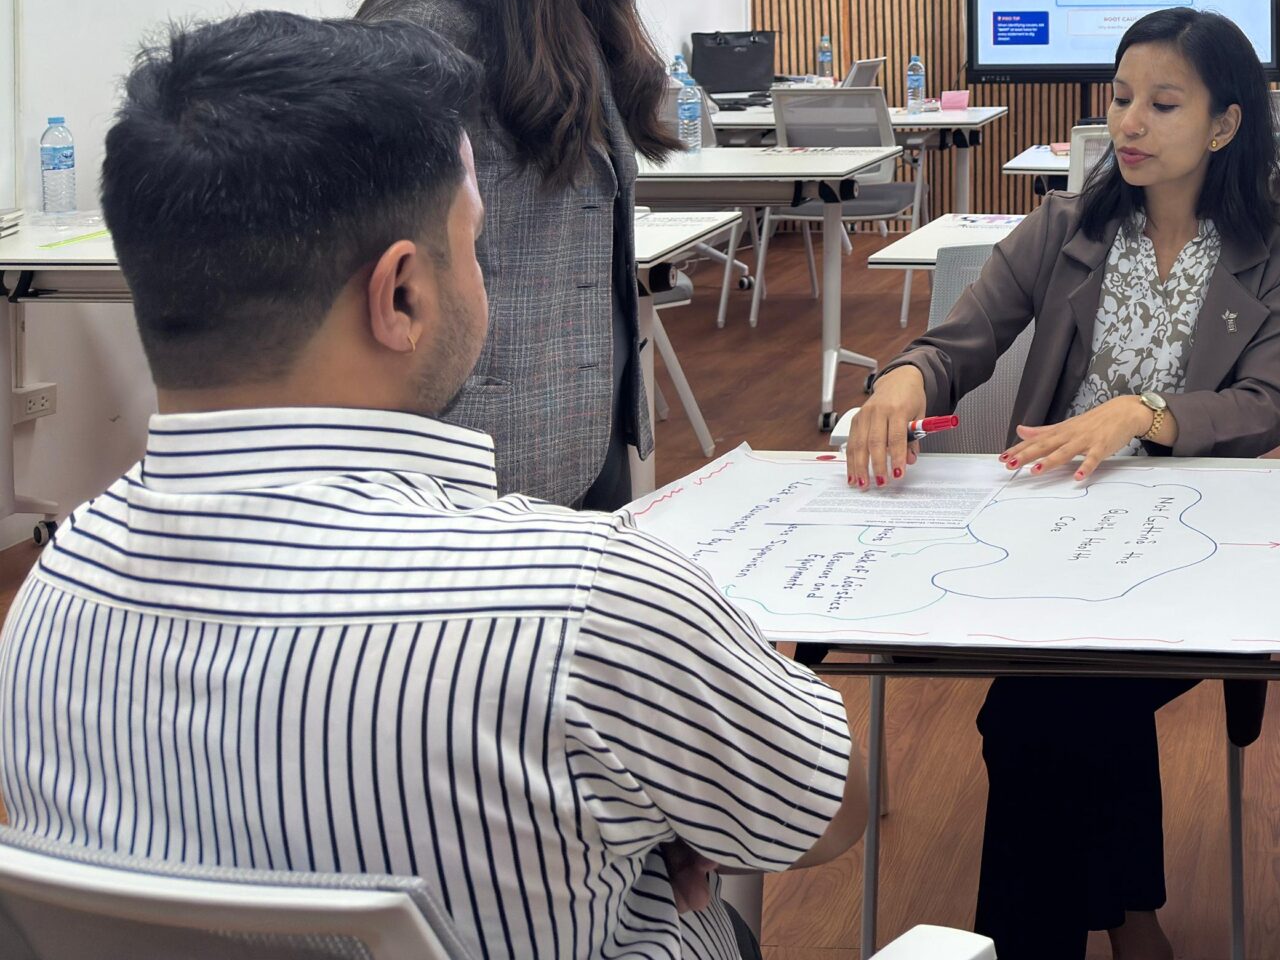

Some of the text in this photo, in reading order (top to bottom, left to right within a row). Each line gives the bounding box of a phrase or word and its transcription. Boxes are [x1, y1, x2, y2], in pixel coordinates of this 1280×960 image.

[1152, 497, 1175, 511] Not
[1051, 516, 1076, 532] Care
[697, 538, 733, 546] by
[1067, 538, 1106, 560] Health
[856, 550, 887, 563] Lack
[1116, 552, 1143, 564] the
[783, 554, 826, 589] Equipments
[806, 583, 824, 598] and
